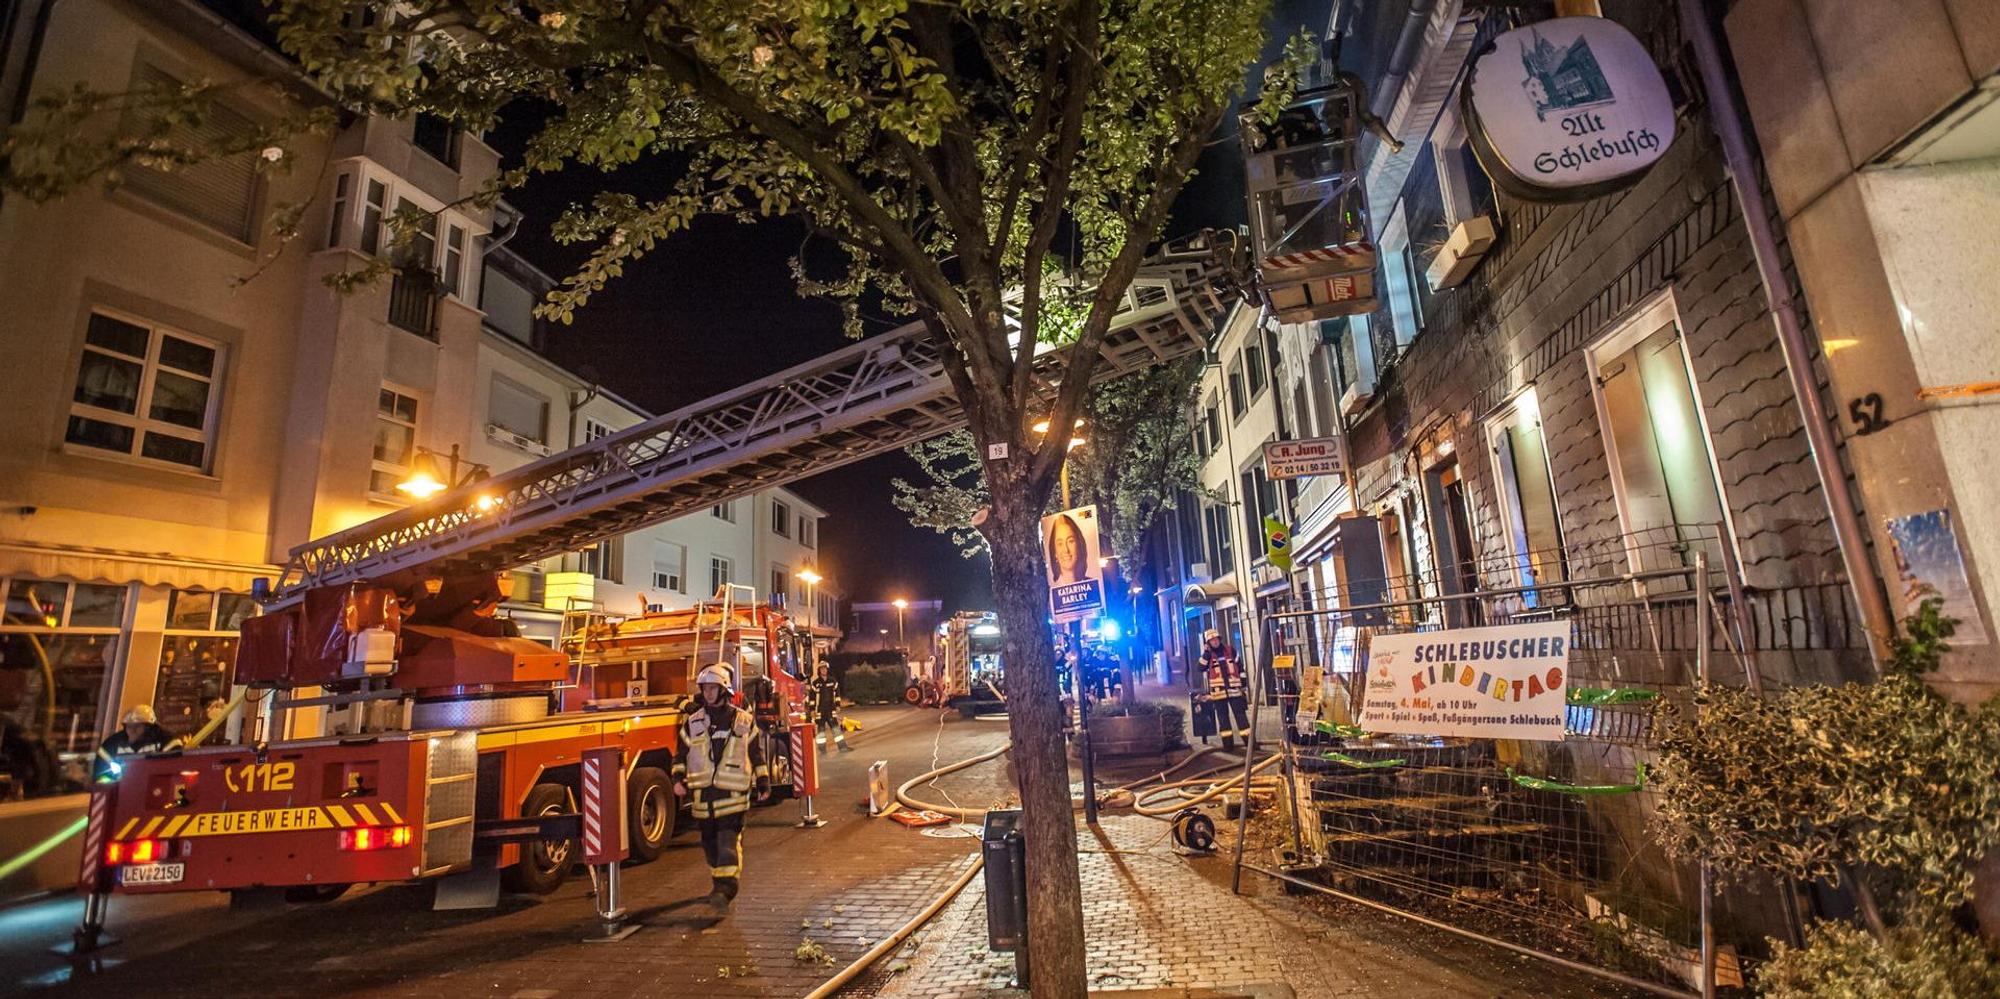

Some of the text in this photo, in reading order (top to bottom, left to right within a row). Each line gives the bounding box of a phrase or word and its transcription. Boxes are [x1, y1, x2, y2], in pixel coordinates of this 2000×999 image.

[1561, 111, 1605, 136] Alt
[1850, 393, 1890, 436] 52
[994, 447, 1003, 455] 19
[1295, 444, 1325, 456] Jung
[1058, 583, 1092, 597] KATARINA
[1062, 593, 1088, 605] BARLEY
[1414, 636, 1564, 663] SCHLEBUSCHER
[1411, 663, 1563, 702] KINDERTAG
[1366, 698, 1478, 711] Samstag, 4. Mai, ab 10 Uhr
[1365, 711, 1561, 726] Sport Spiel Spaß, Fußgängerzone Schlebusch
[240, 762, 295, 792] 112
[197, 809, 317, 833] FEUERWEHR
[124, 867, 147, 881] LEV
